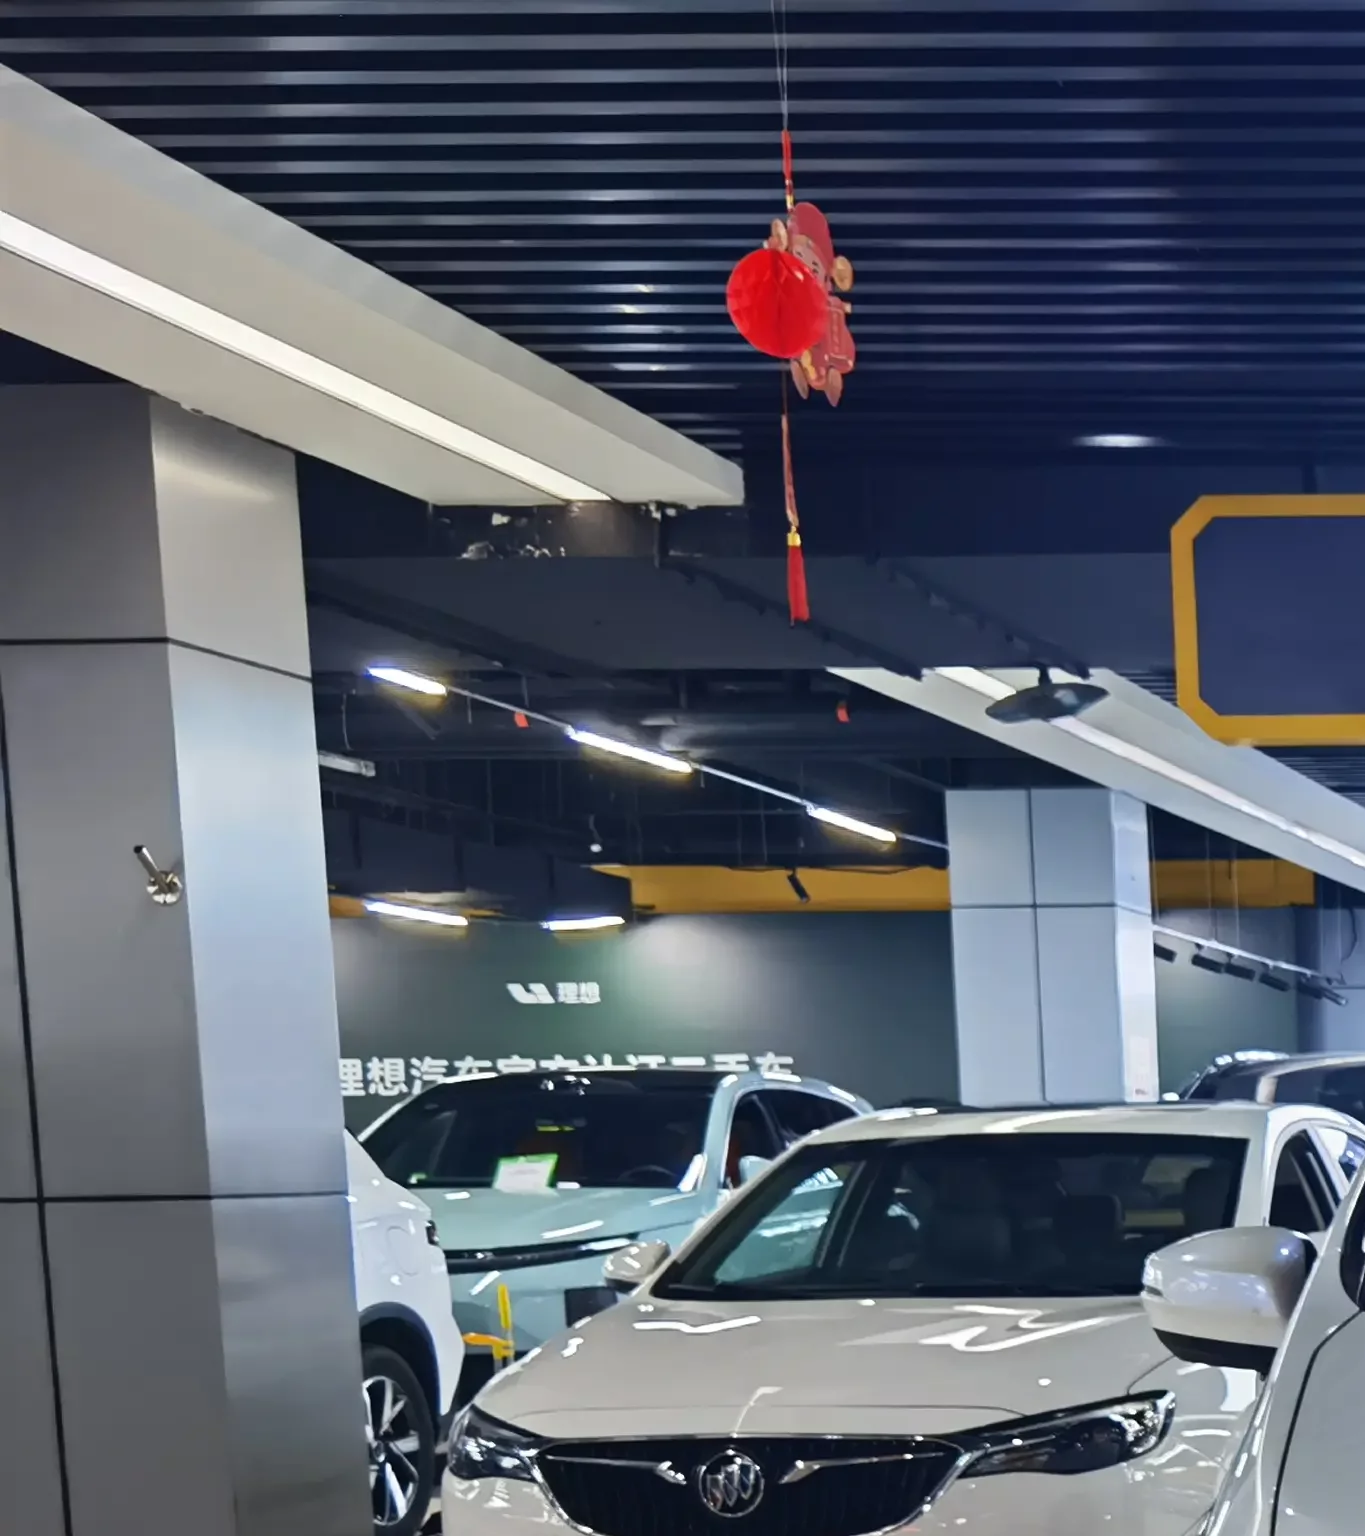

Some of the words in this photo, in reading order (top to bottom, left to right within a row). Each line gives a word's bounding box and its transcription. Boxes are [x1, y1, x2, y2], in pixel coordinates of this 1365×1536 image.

[339, 1053, 795, 1098] 理想汽车官车
